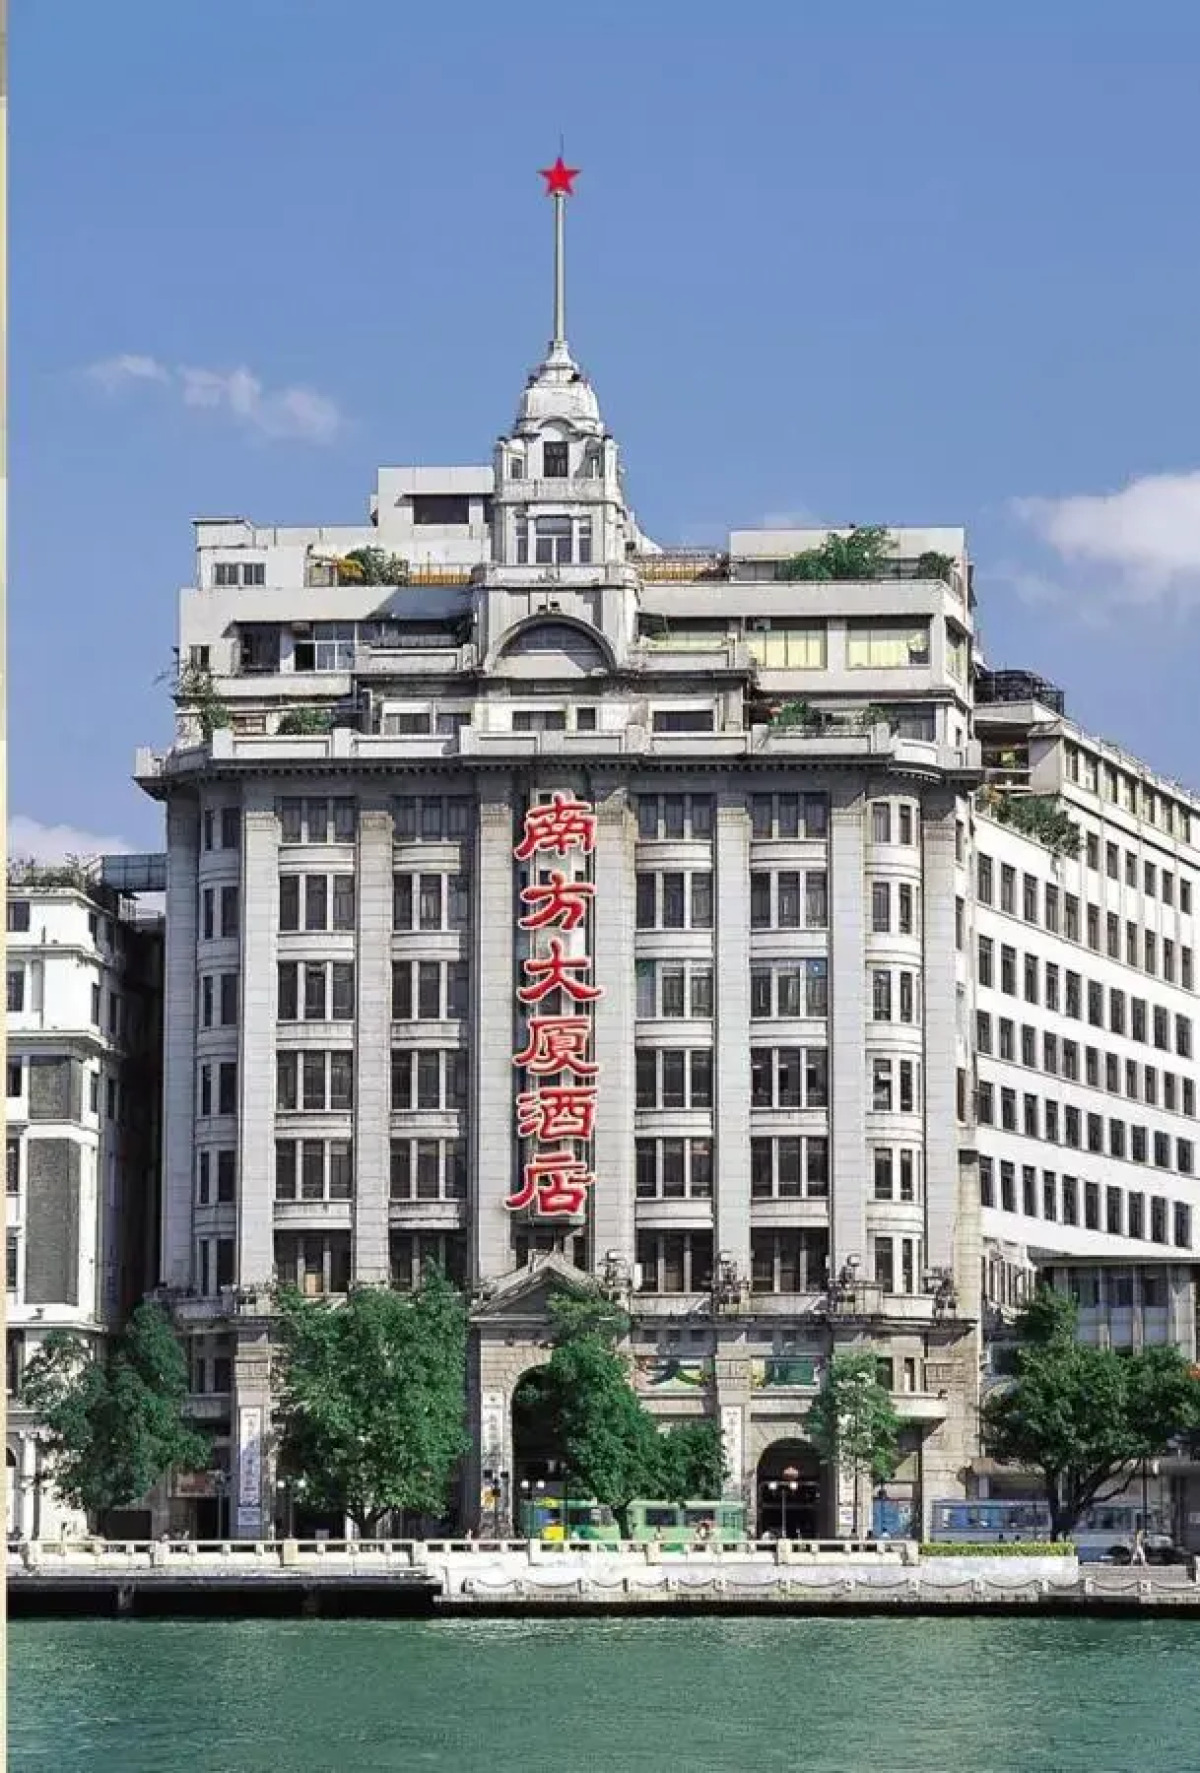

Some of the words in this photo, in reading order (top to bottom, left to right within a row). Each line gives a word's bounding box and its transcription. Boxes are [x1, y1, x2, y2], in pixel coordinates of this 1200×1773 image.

[505, 793, 604, 1214] 南方大厦酒店
